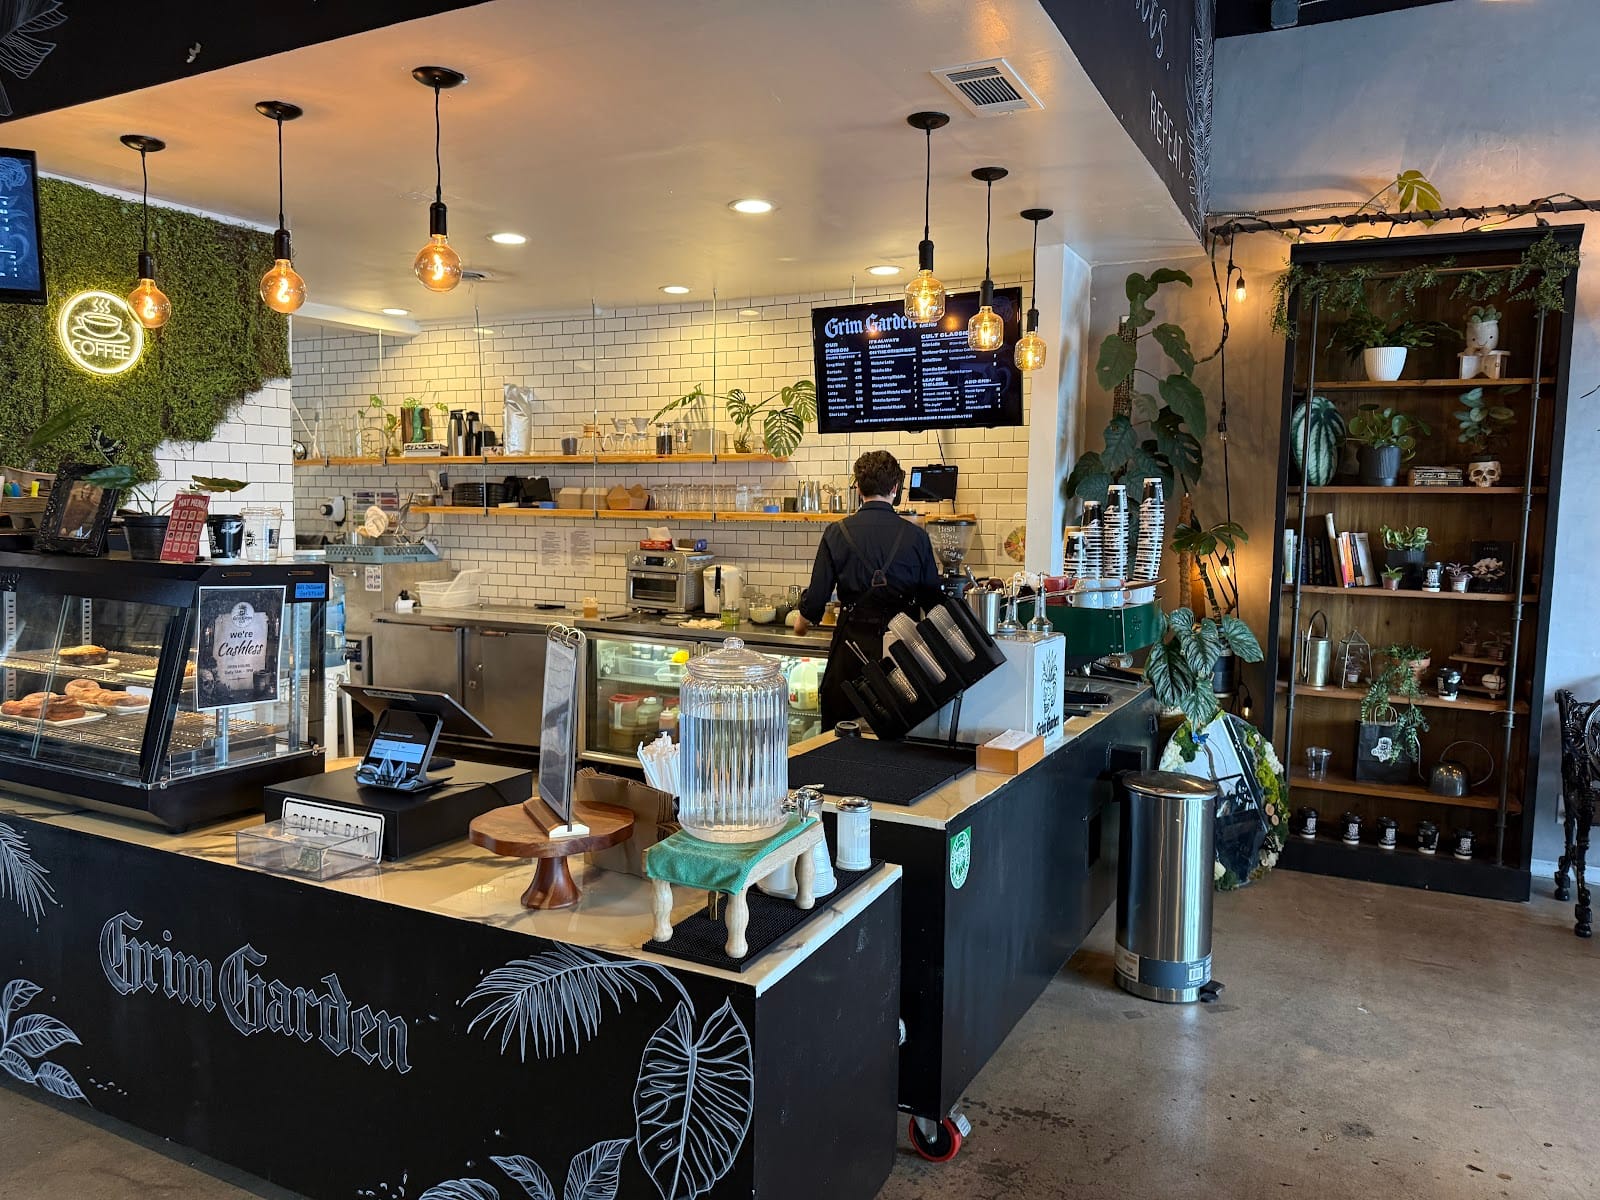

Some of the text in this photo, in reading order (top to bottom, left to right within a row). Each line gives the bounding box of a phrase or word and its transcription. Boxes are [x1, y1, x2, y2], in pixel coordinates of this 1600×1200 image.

[825, 317, 864, 338] Grim
[865, 313, 917, 333] Garden
[71, 339, 131, 360] COFFEE
[229, 630, 254, 639] we're
[218, 639, 264, 658] Cashless
[99, 910, 412, 1075] Grim Garden
